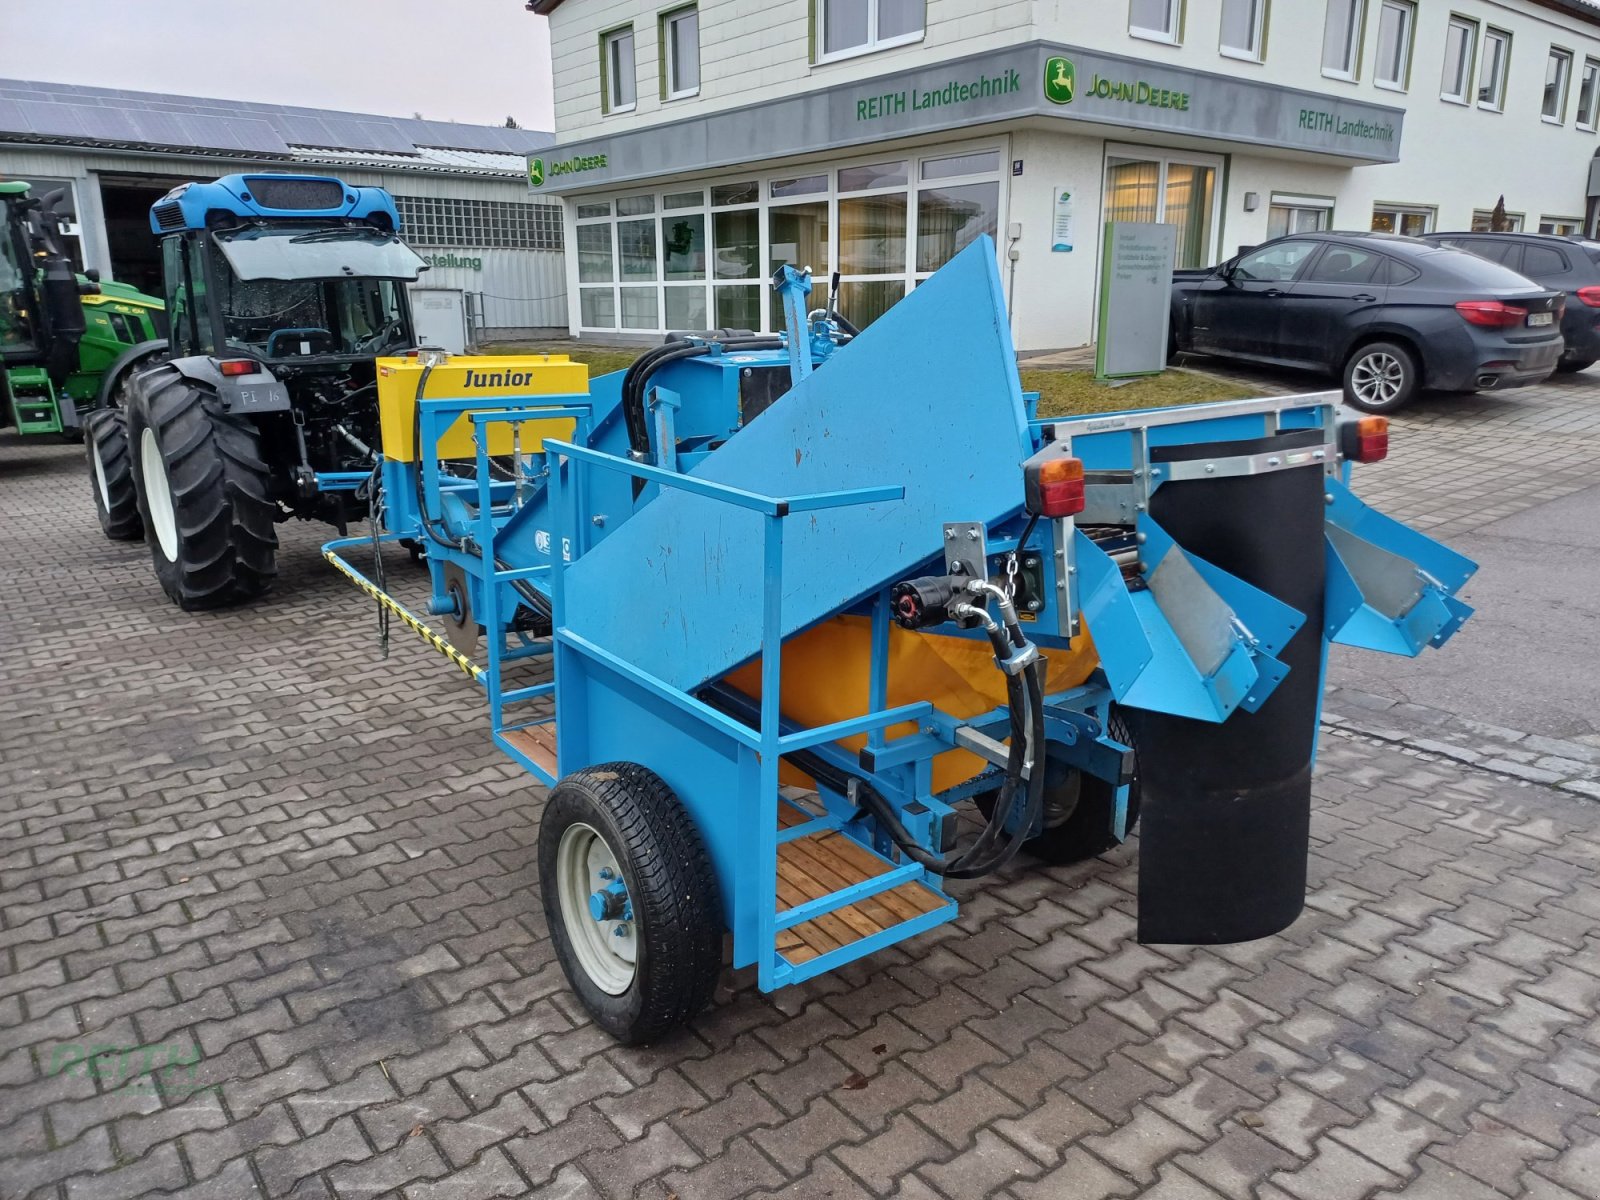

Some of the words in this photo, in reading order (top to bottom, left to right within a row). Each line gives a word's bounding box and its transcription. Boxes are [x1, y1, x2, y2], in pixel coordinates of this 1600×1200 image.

[857, 92, 906, 121] REITH
[912, 69, 1020, 111] Landtechnik
[1085, 73, 1134, 102] JOHN
[1135, 81, 1190, 111] DEERE
[1299, 109, 1333, 132] REITH
[1336, 115, 1395, 142] Landtechnik
[548, 160, 574, 177] JOHN
[573, 153, 608, 173] DEERE
[424, 253, 482, 271] stellung
[464, 369, 533, 388] Junior
